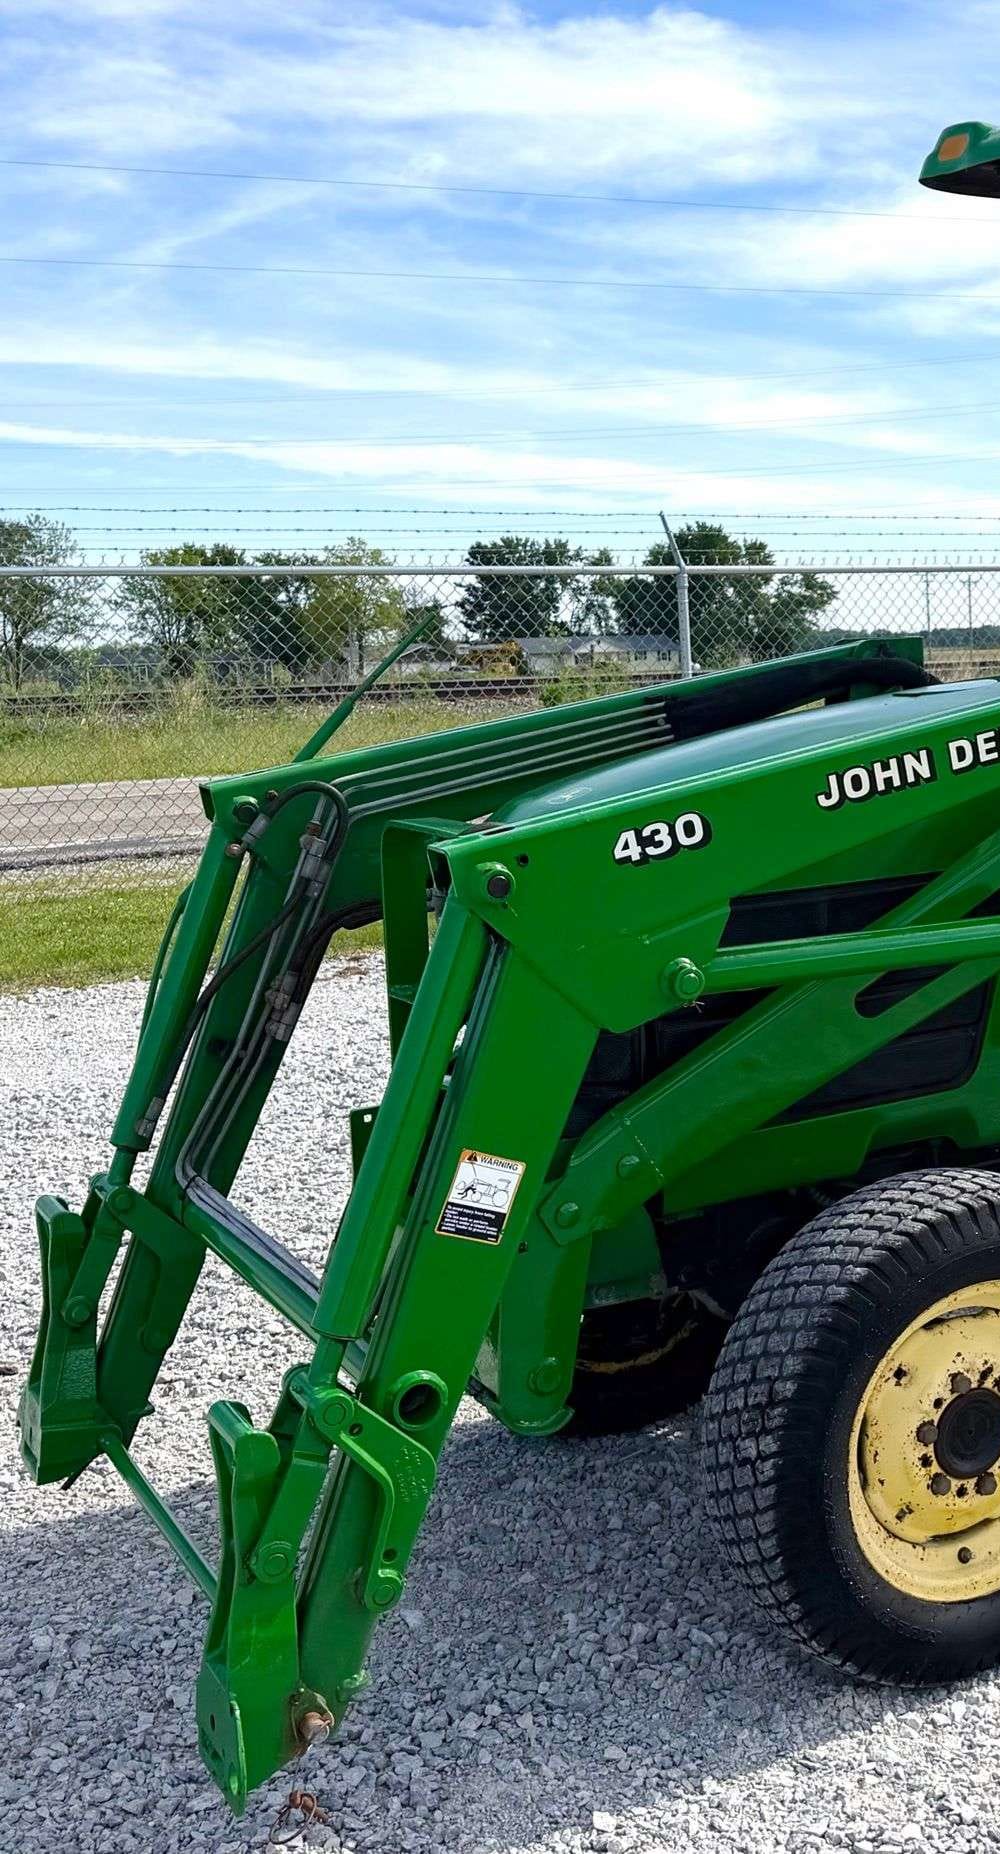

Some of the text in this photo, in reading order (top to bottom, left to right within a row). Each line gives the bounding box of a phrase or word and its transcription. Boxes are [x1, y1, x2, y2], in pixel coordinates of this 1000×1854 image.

[817, 748, 935, 809] JOHN
[613, 811, 710, 865] 430
[480, 1155, 519, 1171] WARNING
